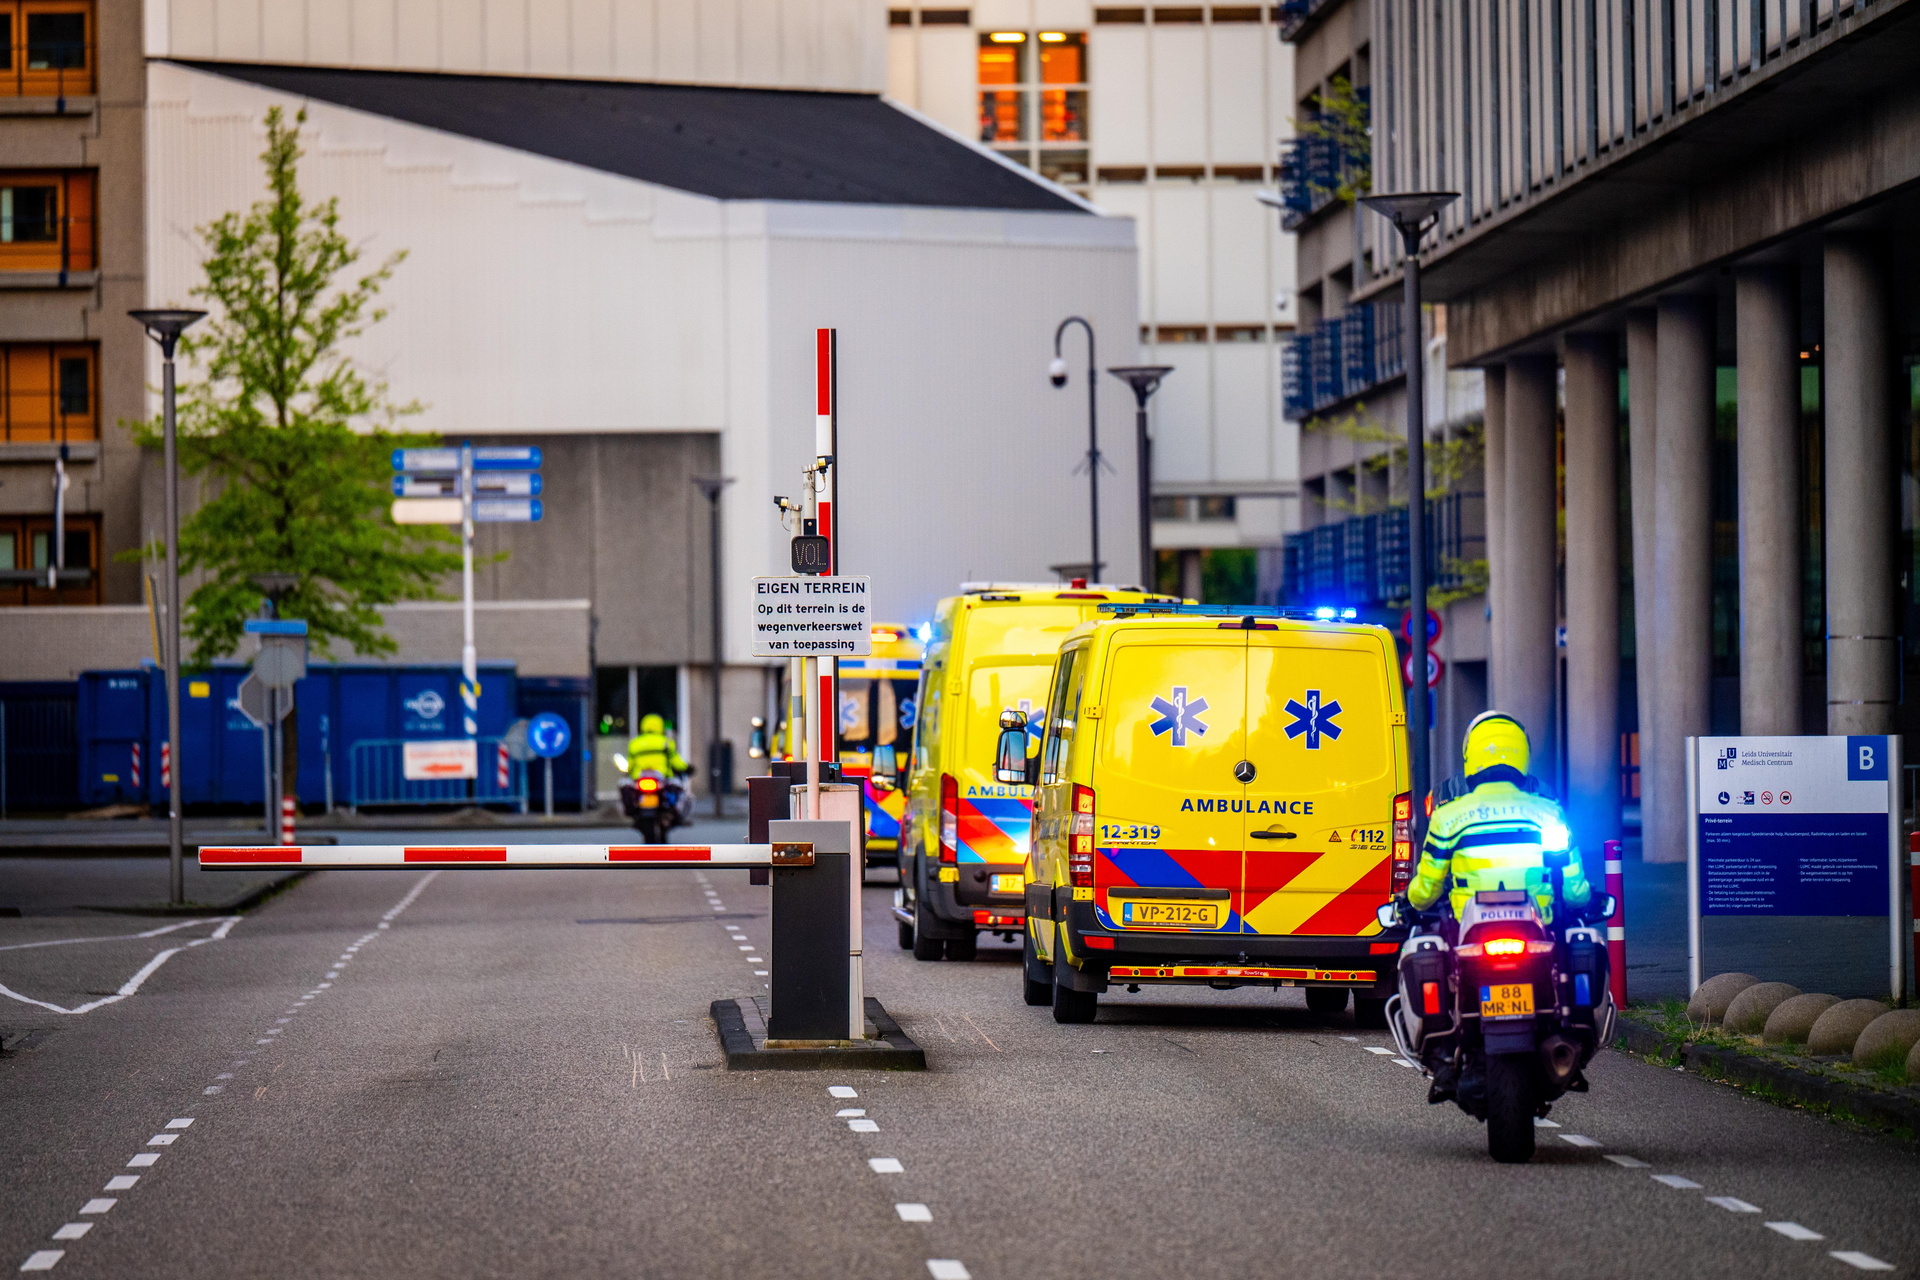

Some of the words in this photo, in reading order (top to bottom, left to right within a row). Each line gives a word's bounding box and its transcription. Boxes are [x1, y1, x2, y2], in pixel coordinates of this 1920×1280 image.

[794, 543, 827, 566] VOL
[757, 583, 799, 594] EIGEN
[804, 583, 865, 594] TERREIN
[757, 604, 773, 615] Op
[776, 604, 792, 614] dit
[796, 604, 835, 614] terrein
[839, 604, 849, 613] is
[852, 604, 866, 613] de
[757, 621, 863, 634] wegenverkeerswet
[768, 641, 790, 650] van
[793, 640, 855, 652] toepassing
[1859, 746, 1874, 770] B
[1180, 798, 1314, 815] AMBULANCE
[1101, 824, 1161, 839] 12-319
[1139, 906, 1208, 922] VP-212-G
[1481, 910, 1525, 920] POLITIE
[1501, 986, 1522, 999] 88
